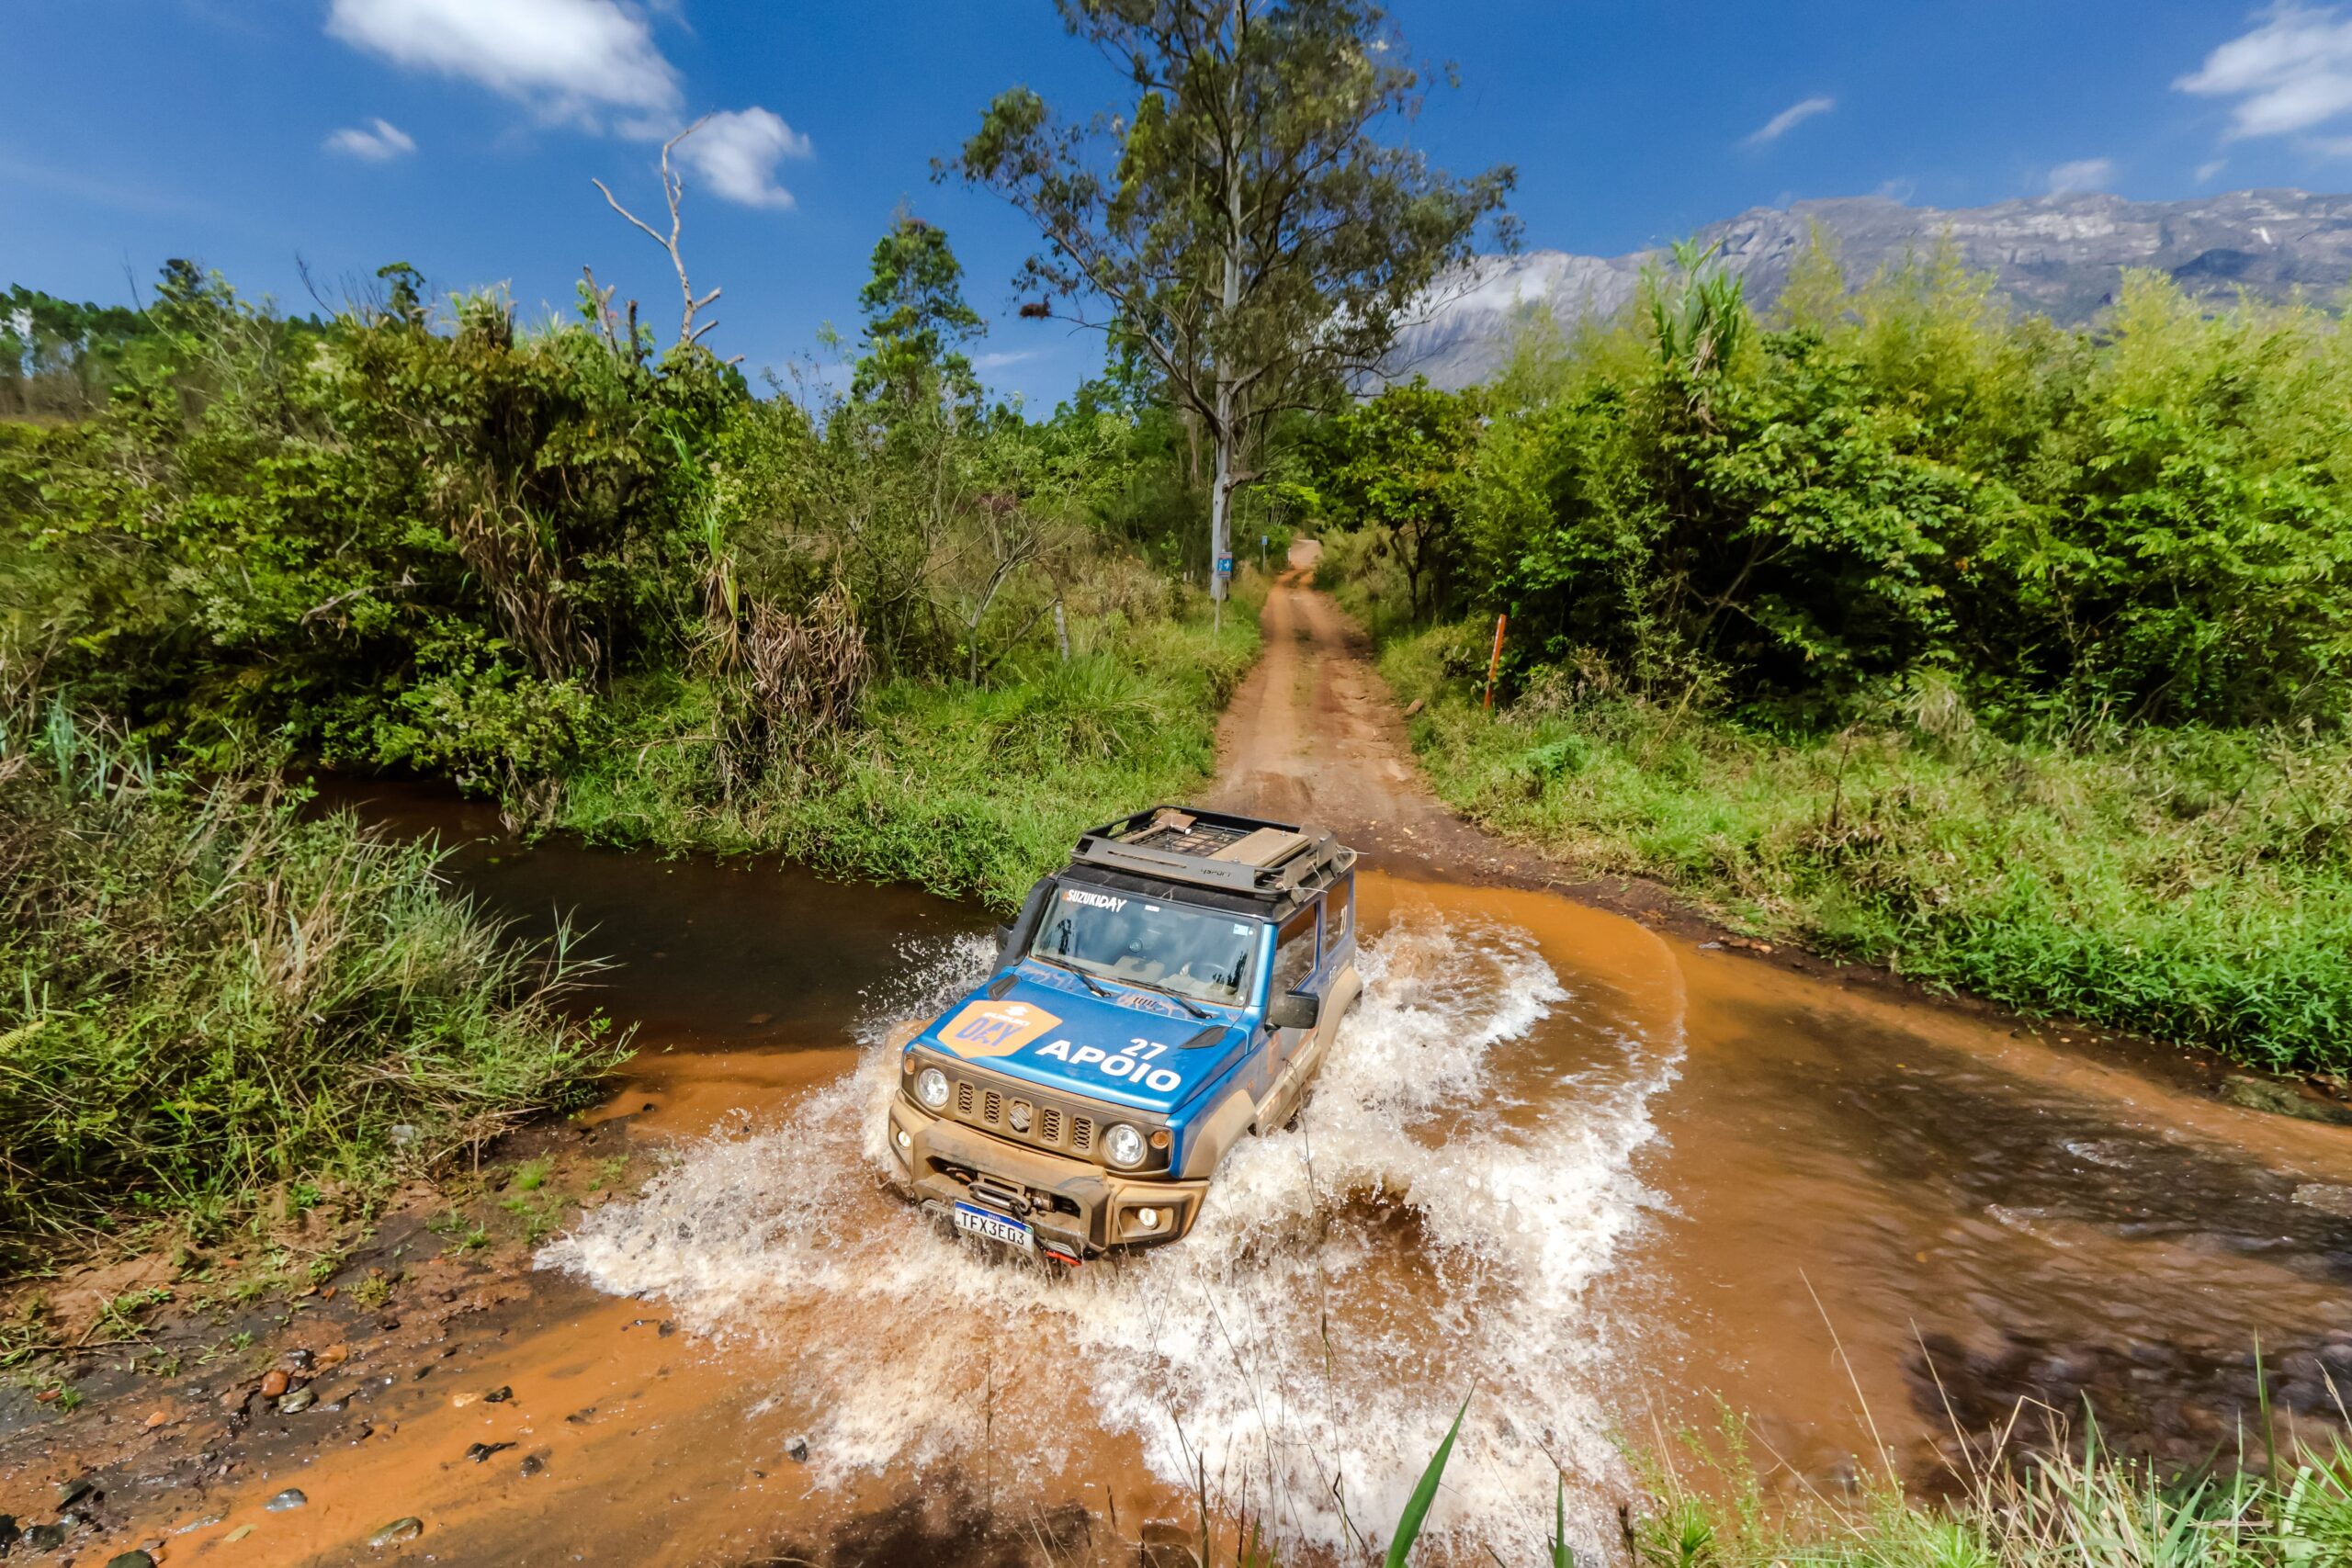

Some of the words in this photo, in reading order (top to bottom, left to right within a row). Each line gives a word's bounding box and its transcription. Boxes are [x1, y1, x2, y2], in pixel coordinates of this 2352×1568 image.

[956, 1015, 1023, 1046] DAY
[1120, 1038, 1169, 1061] 27
[1035, 1039, 1182, 1092] APOIO
